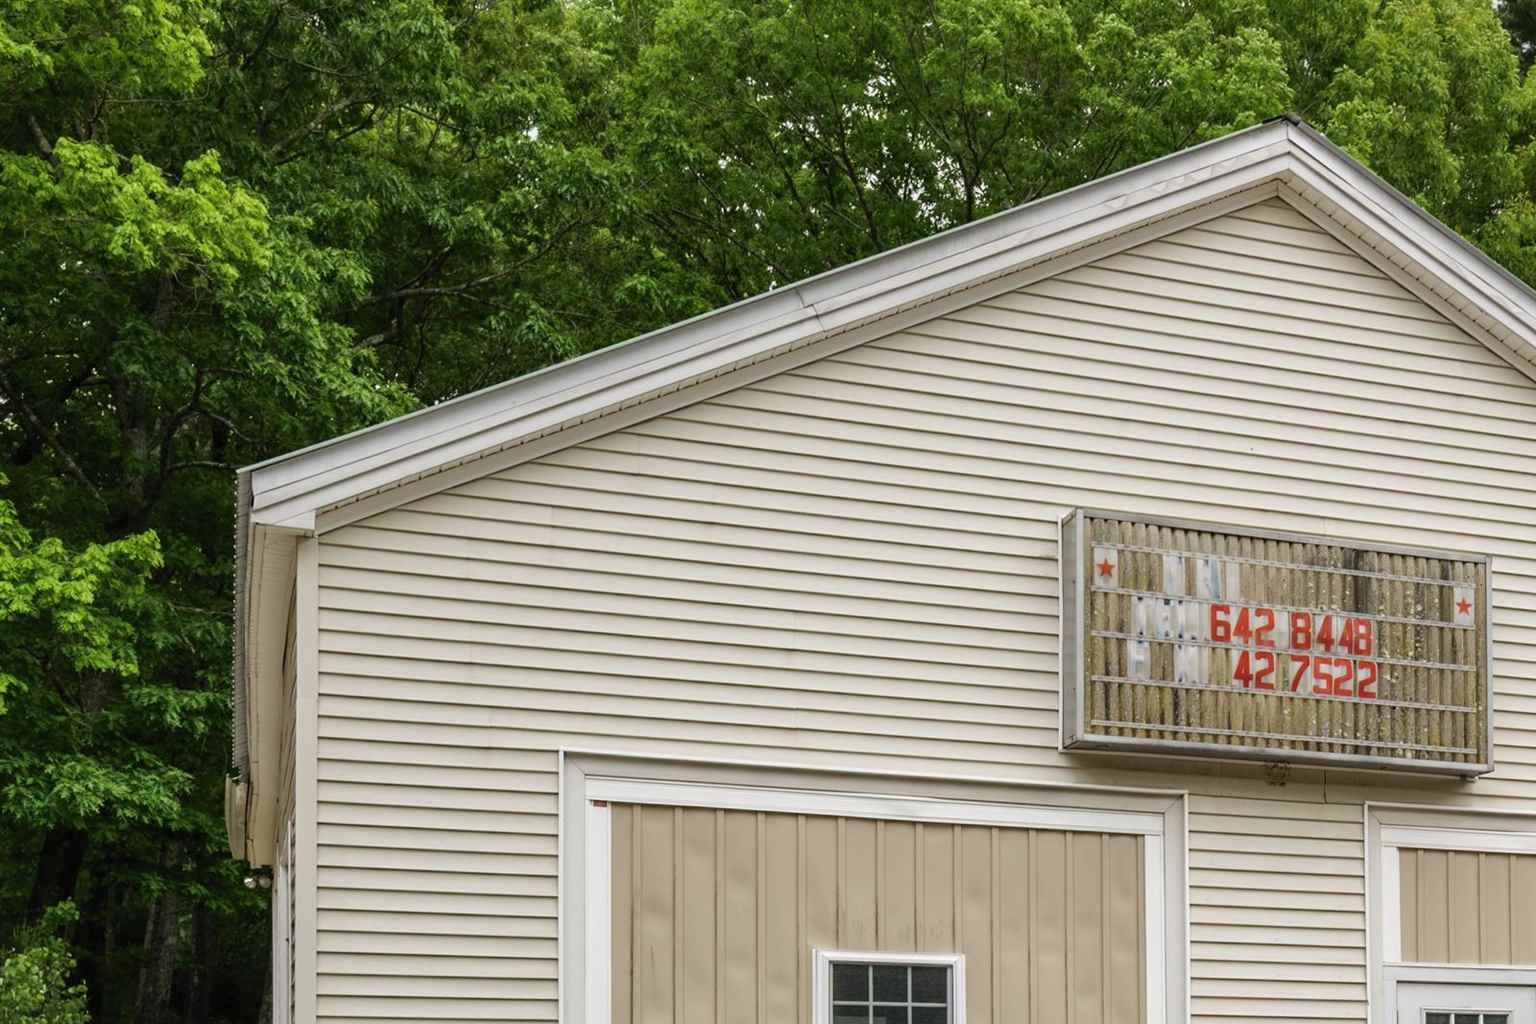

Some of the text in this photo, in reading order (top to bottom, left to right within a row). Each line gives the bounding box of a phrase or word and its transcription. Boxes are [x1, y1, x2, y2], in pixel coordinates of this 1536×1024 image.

[1210, 604, 1373, 657] 642 8448
[1233, 651, 1377, 699] 42 7522
